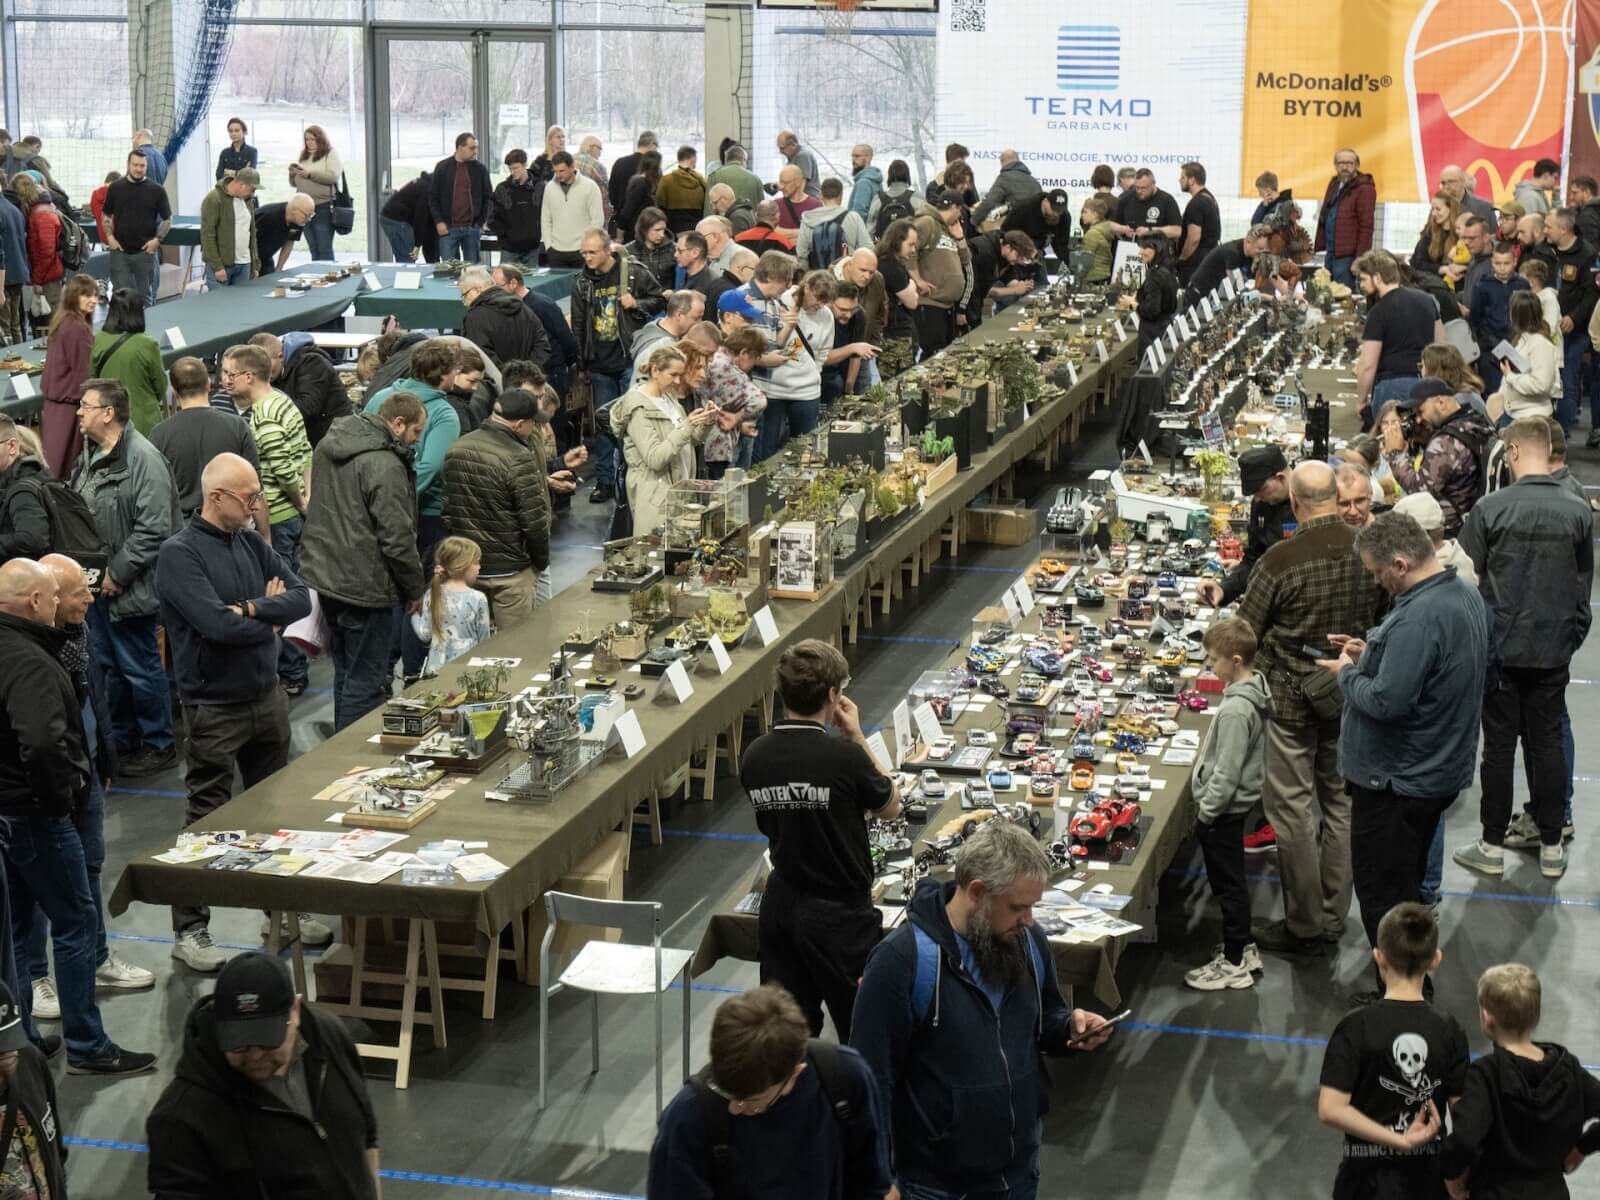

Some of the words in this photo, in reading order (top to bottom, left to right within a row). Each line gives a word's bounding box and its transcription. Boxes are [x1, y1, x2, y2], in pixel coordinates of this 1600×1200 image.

[1024, 97, 1151, 117] TERMO
[1284, 99, 1362, 118] BYTOM
[1047, 120, 1128, 131] GARBACKI
[1142, 154, 1200, 165] KOMFORT
